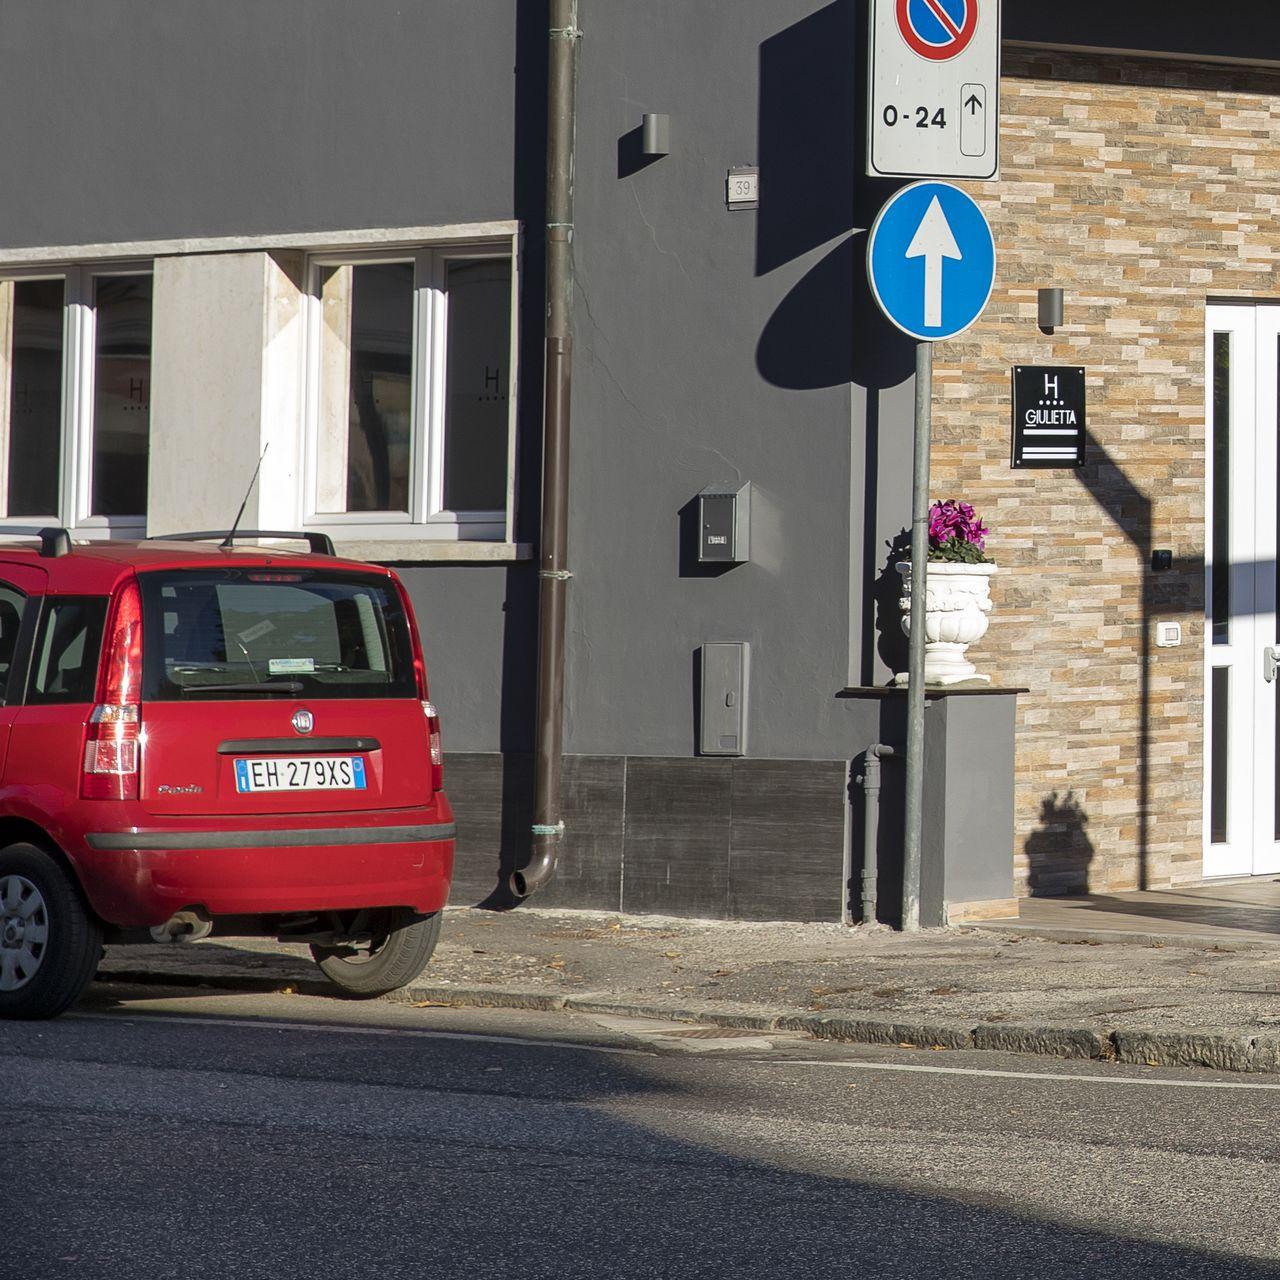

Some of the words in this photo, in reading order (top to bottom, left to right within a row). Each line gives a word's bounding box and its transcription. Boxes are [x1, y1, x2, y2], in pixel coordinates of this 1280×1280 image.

[736, 181, 750, 195] 39
[485, 366, 499, 393] H
[1044, 373, 1058, 399] H
[1025, 409, 1077, 425] GIULIETTA
[287, 761, 351, 786] 279XS
